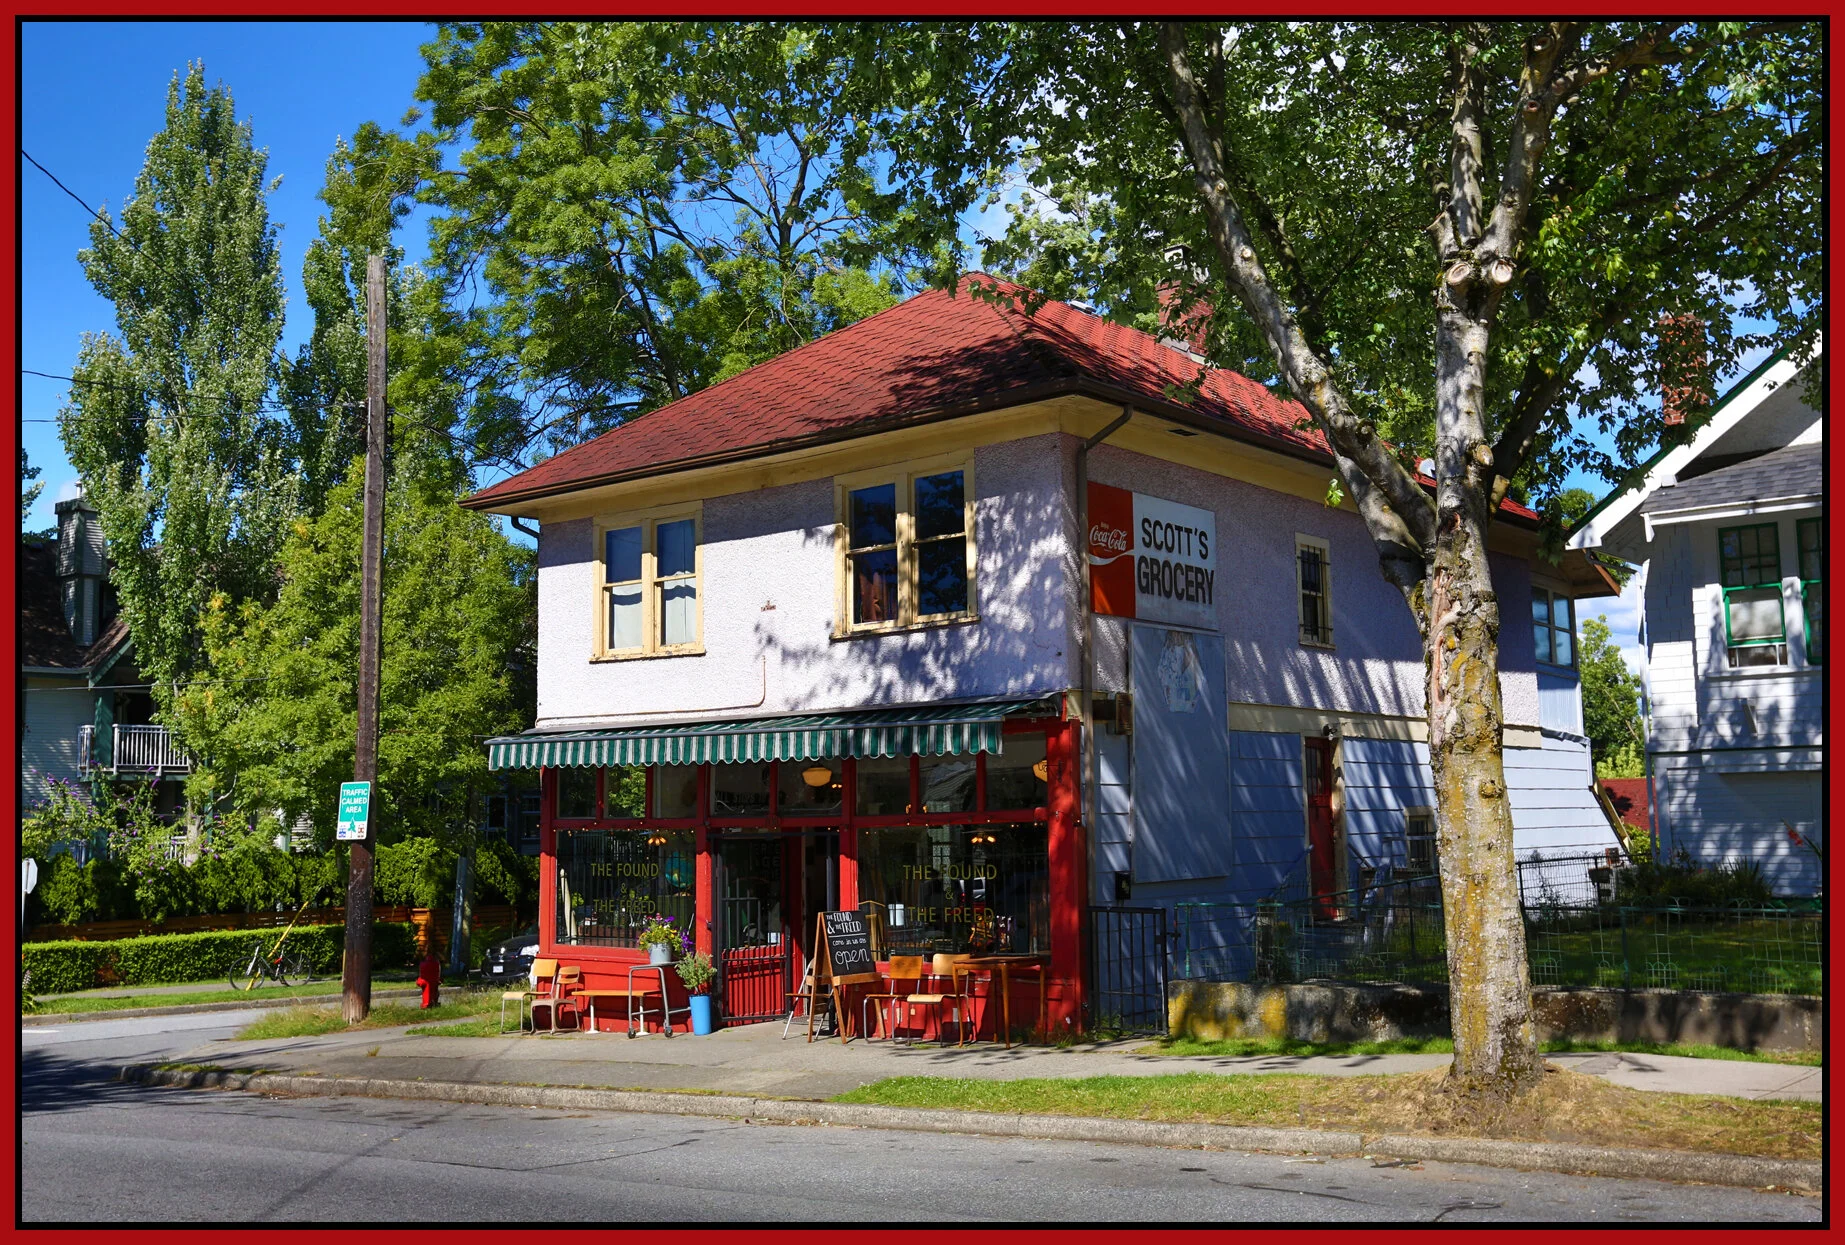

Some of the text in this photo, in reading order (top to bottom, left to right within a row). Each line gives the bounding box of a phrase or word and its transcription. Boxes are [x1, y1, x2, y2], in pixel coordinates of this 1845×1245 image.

[1089, 525, 1127, 551] Coca-Cola
[1141, 517, 1209, 560] SCOTT'S
[1137, 555, 1214, 605] GROCERY
[342, 788, 368, 796] TRAFFIC
[342, 797, 367, 805] CALMED
[591, 863, 659, 877] THE FOUND
[903, 864, 997, 880] THE FOUND
[620, 882, 627, 894] &
[945, 887, 954, 899] &
[593, 899, 656, 914] THE FREED
[834, 912, 852, 922] FOUND
[908, 906, 994, 923] THE FREED
[827, 921, 836, 934] &
[841, 921, 862, 933] FREED
[835, 948, 869, 970] open
